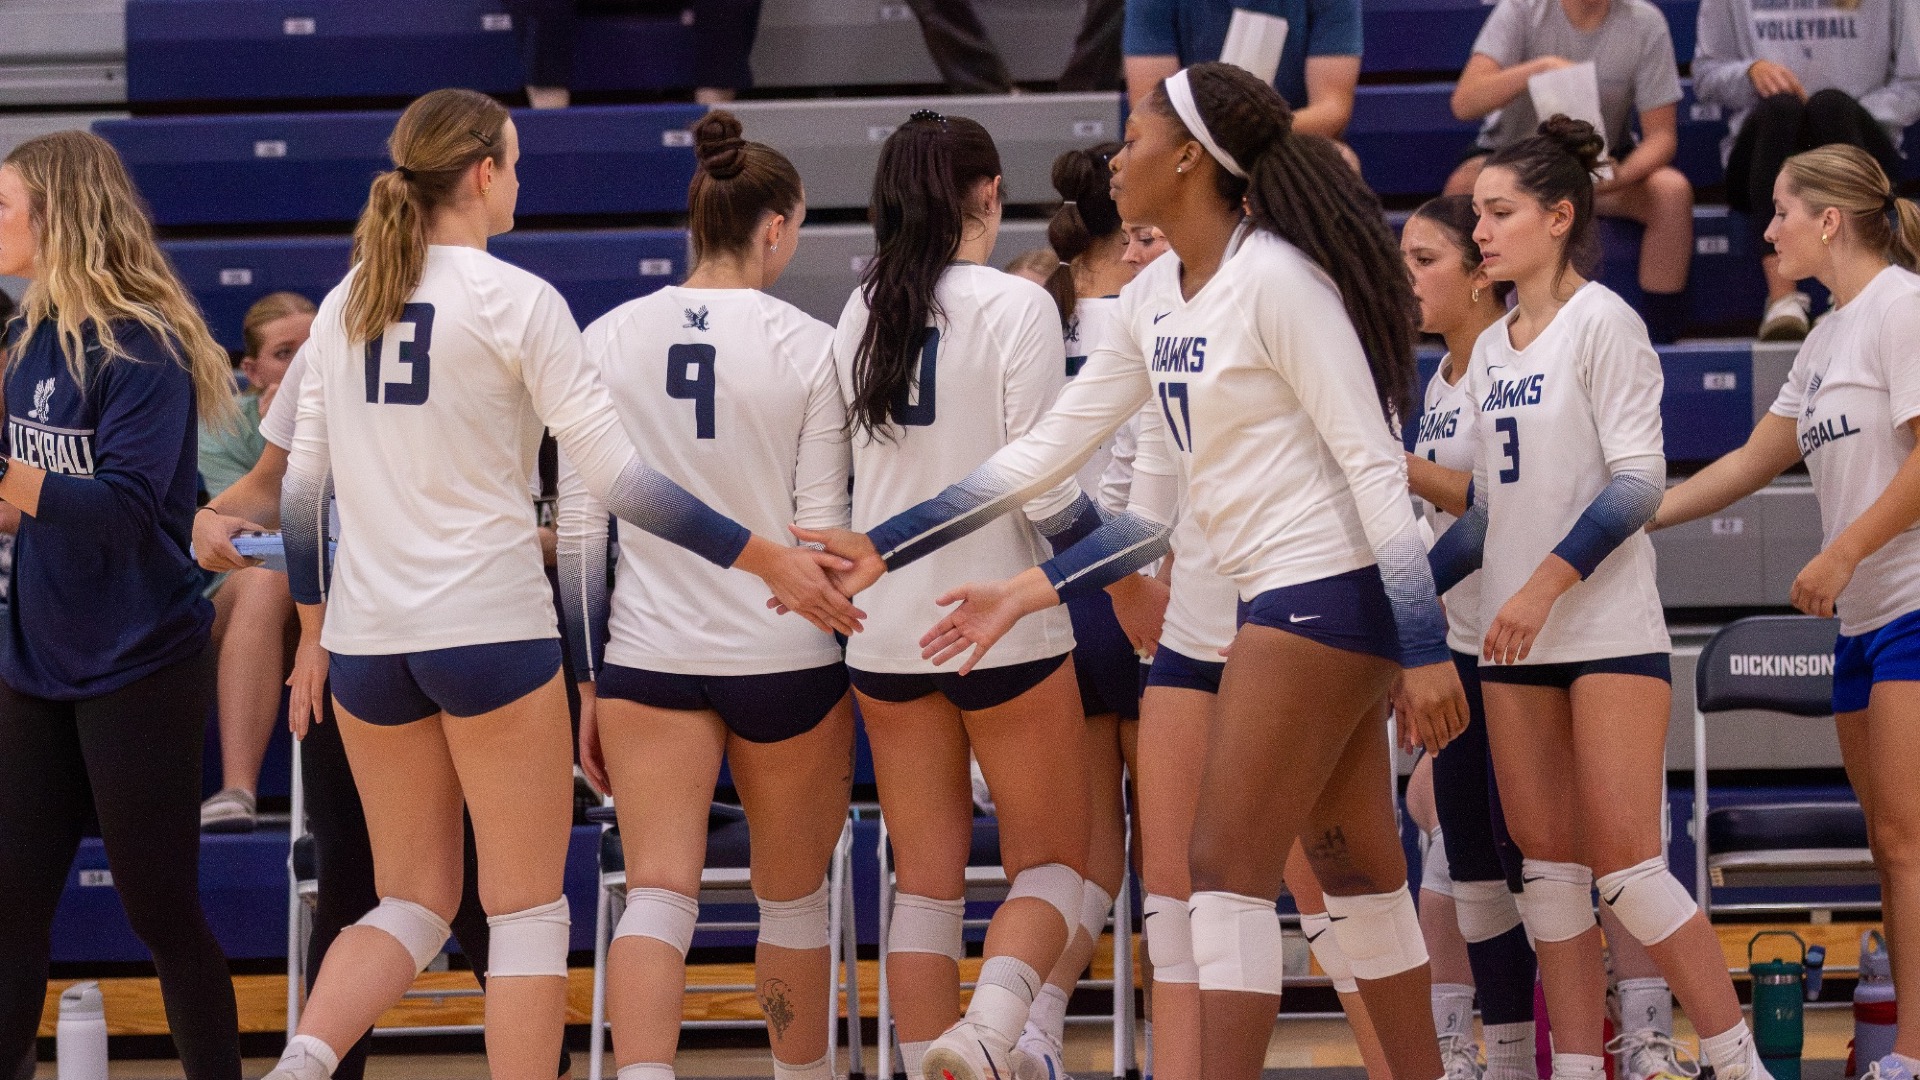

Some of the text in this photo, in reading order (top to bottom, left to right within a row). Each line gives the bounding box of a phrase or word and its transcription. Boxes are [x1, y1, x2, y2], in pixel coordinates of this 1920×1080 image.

[1755, 17, 1857, 41] VOLLEYBALL
[365, 302, 435, 406] 13
[1152, 336, 1208, 373] HAWKS
[666, 343, 716, 439] 9
[1482, 374, 1544, 412] HAWKS
[1158, 381, 1192, 453] 17
[1417, 407, 1460, 444] HAWKS
[1496, 417, 1520, 485] 3
[1730, 654, 1836, 676] DICKINSON
